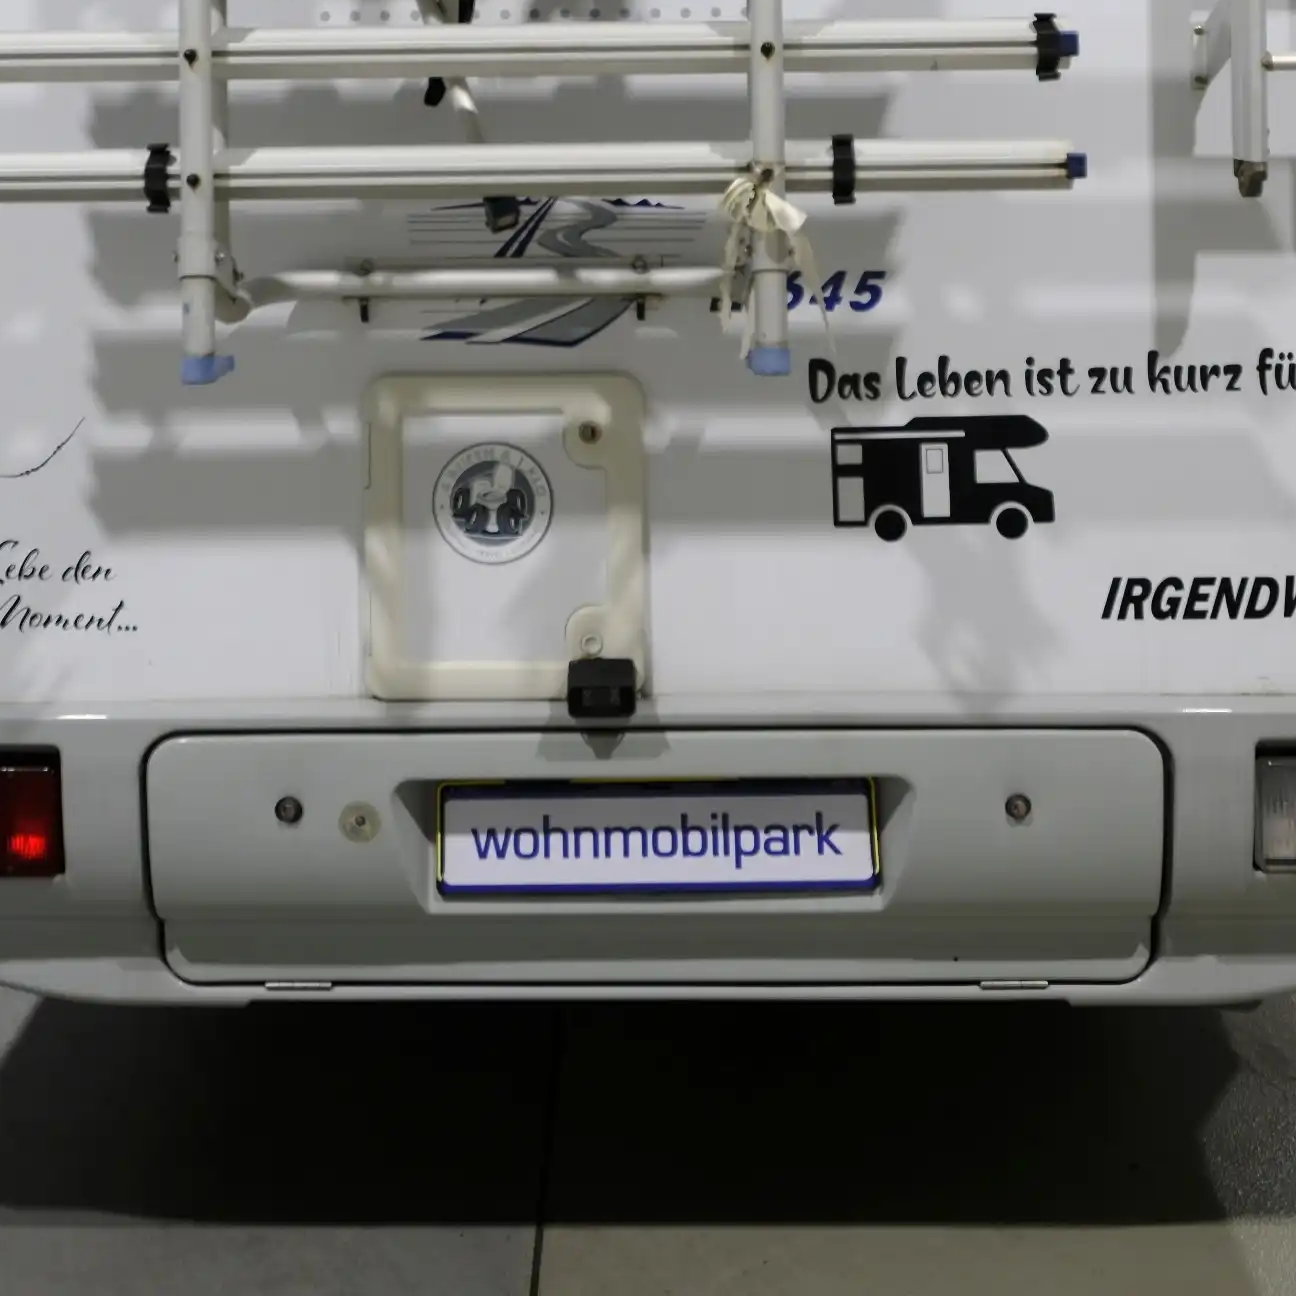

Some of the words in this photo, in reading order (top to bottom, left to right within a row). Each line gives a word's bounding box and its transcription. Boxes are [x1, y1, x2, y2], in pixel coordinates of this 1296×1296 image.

[808, 356, 882, 405] Das
[895, 354, 1012, 401] Leben
[1024, 355, 1080, 397] ist
[1087, 365, 1135, 395] zu
[1147, 349, 1244, 396] kurz
[60, 549, 116, 586] den
[470, 812, 842, 869] wohnmobilpark
